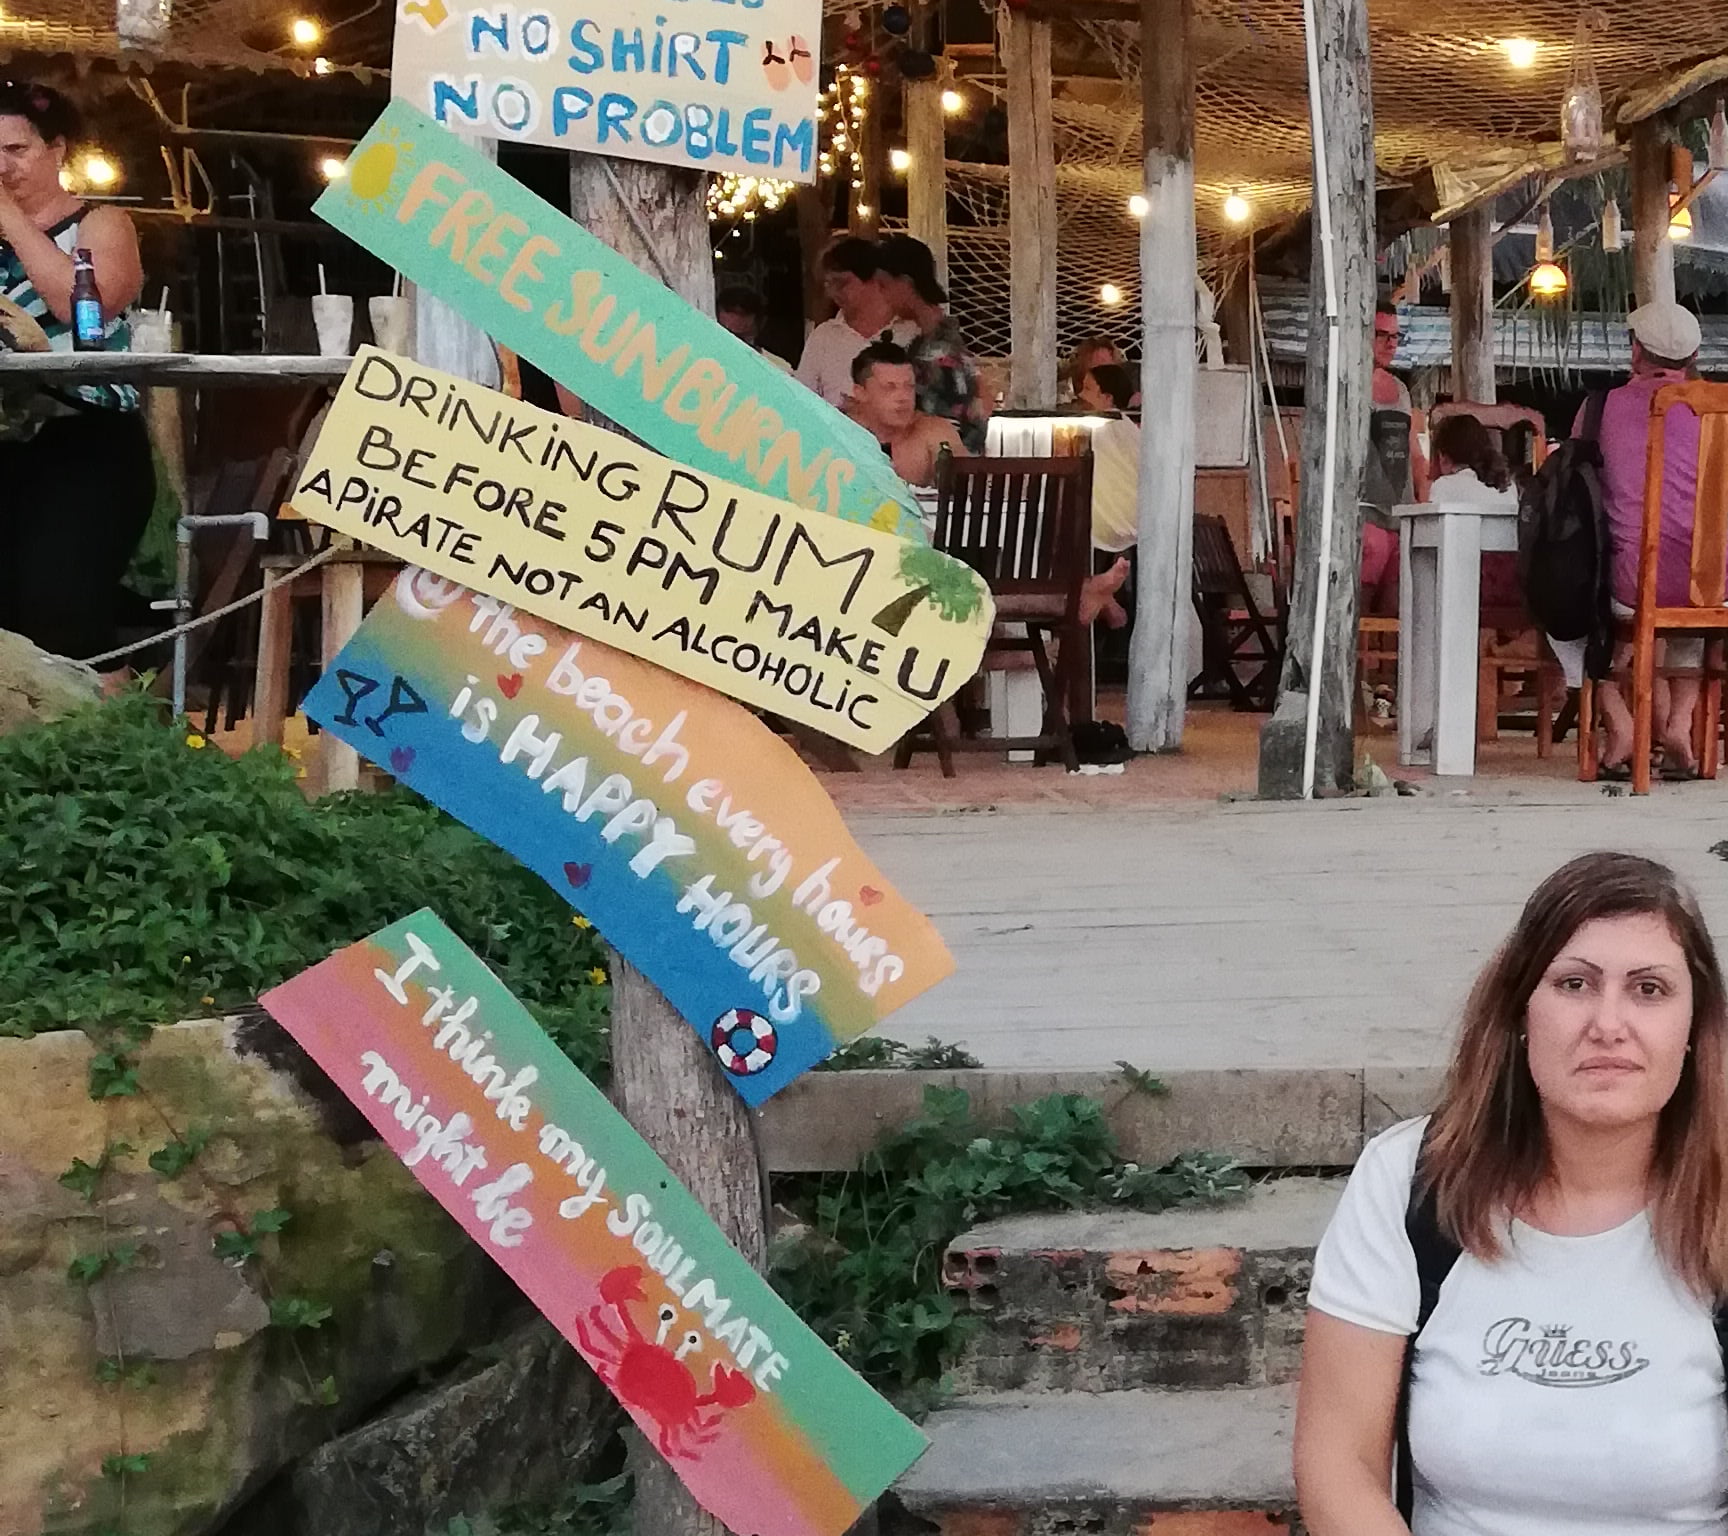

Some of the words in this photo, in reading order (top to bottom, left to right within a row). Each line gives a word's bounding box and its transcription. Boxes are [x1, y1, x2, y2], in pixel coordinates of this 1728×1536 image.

[431, 80, 531, 132] NO
[552, 87, 813, 172] PROBLEM
[471, 12, 552, 55] NO
[396, 161, 562, 312] FREE
[546, 269, 857, 515] SUNBURNS
[357, 425, 568, 541] BEFORE
[746, 591, 884, 677] MAKE
[897, 648, 949, 703] U
[653, 470, 875, 614] RUM
[449, 675, 497, 742] is
[500, 715, 696, 879] HAPPY
[676, 875, 821, 1023] HOURS
[462, 593, 547, 670] the
[545, 642, 690, 783] beach
[687, 779, 793, 898] every
[793, 857, 903, 997] hours
[360, 1051, 488, 1185] might
[471, 1162, 534, 1247] be
[374, 932, 441, 1005] I
[421, 984, 539, 1132] think
[539, 1124, 607, 1219] my
[606, 1194, 789, 1393] SOULMATE
